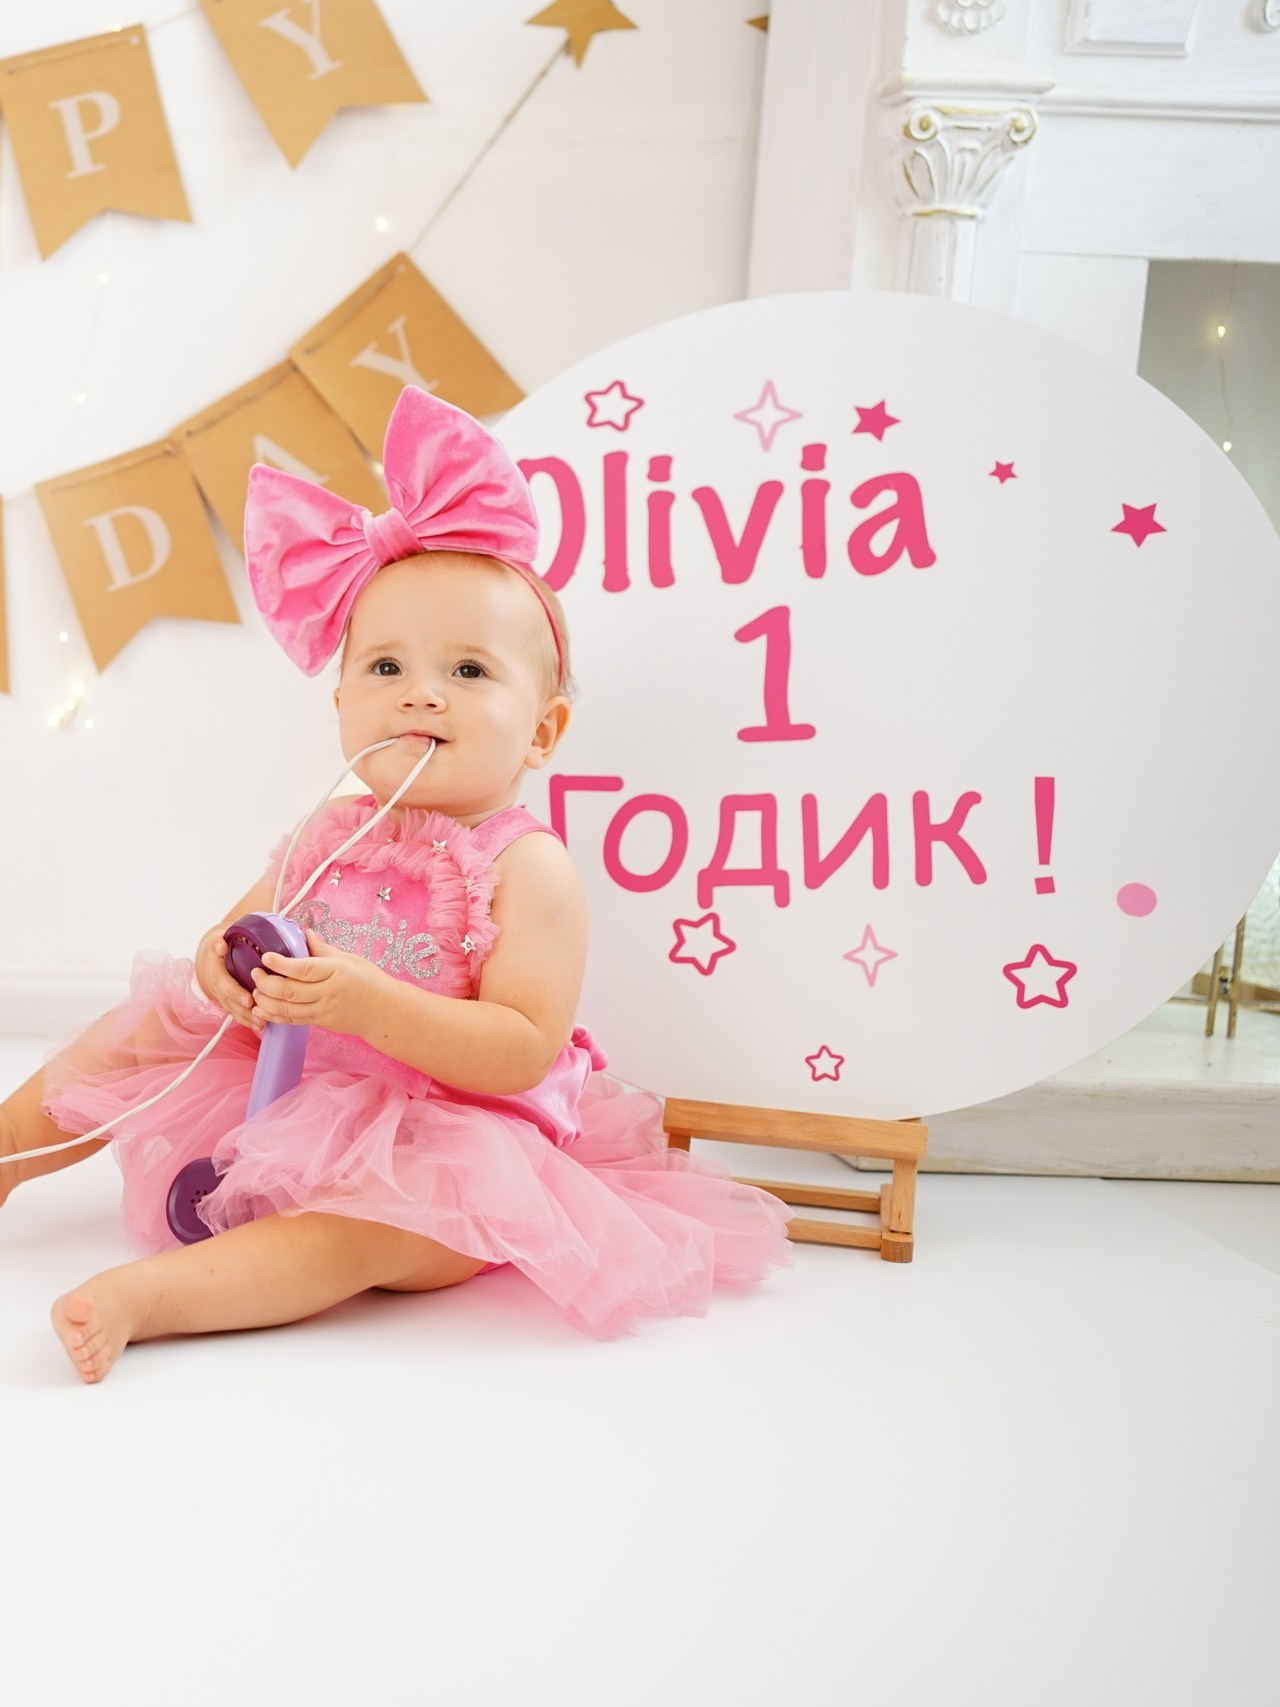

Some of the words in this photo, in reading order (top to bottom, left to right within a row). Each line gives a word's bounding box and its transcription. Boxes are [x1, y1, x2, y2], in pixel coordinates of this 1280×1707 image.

[516, 443, 937, 593] Olivia
[733, 605, 817, 743] 1
[548, 774, 988, 909] Годик
